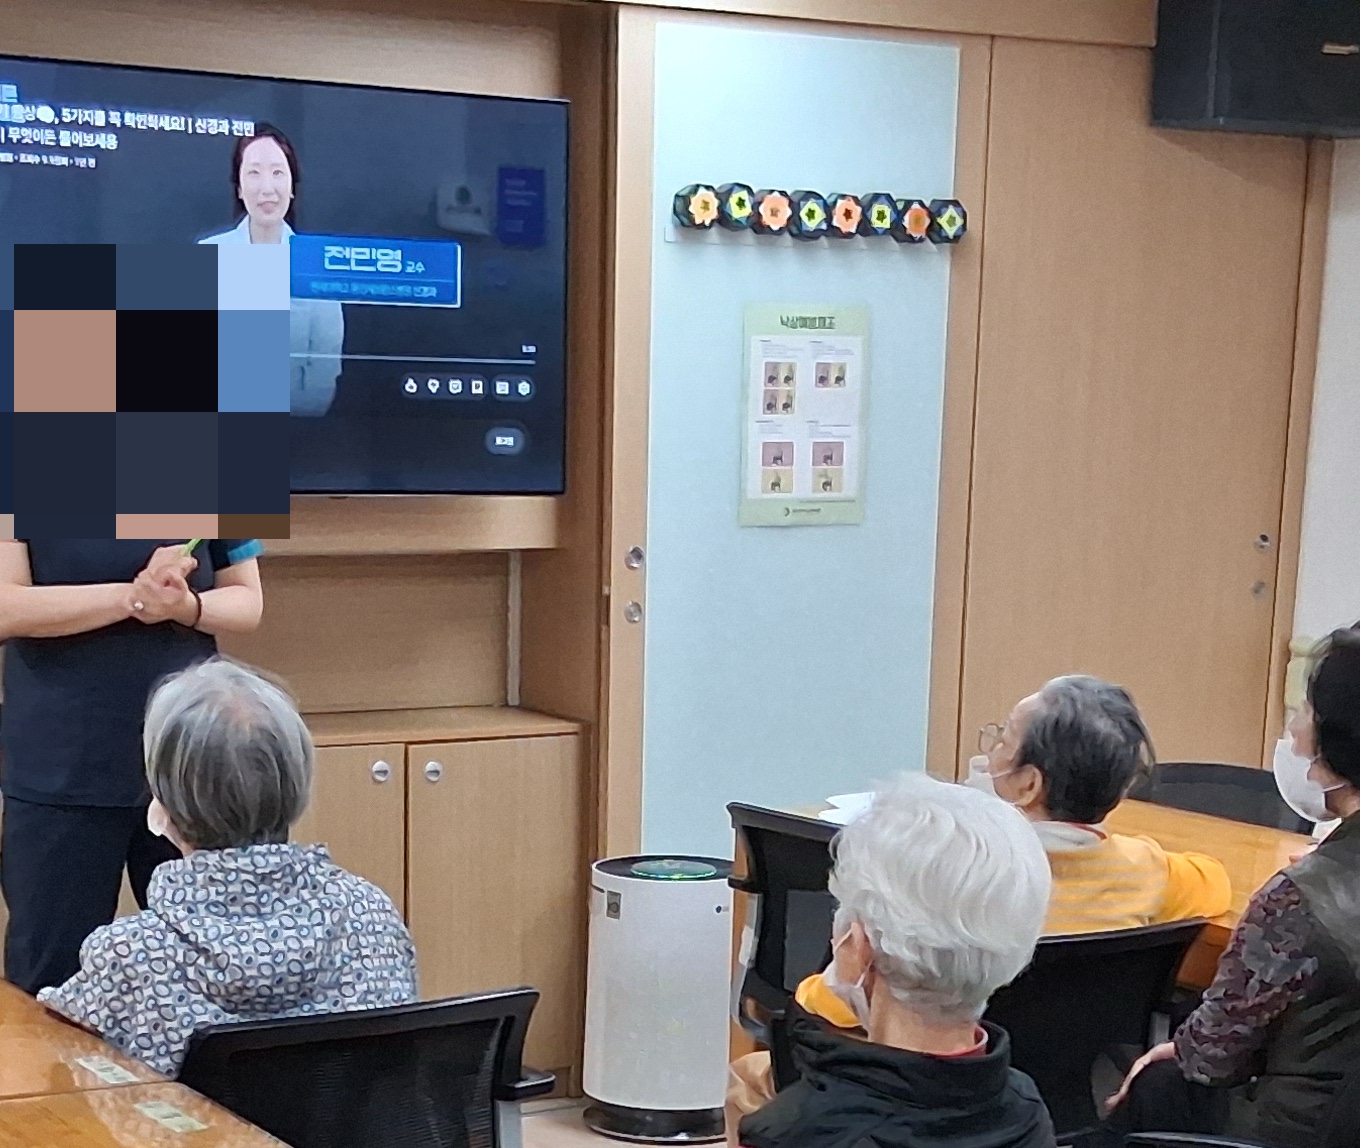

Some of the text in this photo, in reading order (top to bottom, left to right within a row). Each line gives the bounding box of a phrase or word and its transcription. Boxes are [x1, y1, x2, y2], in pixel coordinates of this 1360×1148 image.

[8, 127, 57, 145] 무엇이든
[195, 117, 230, 136] 신경과
[324, 246, 426, 274] 전민영 교수
